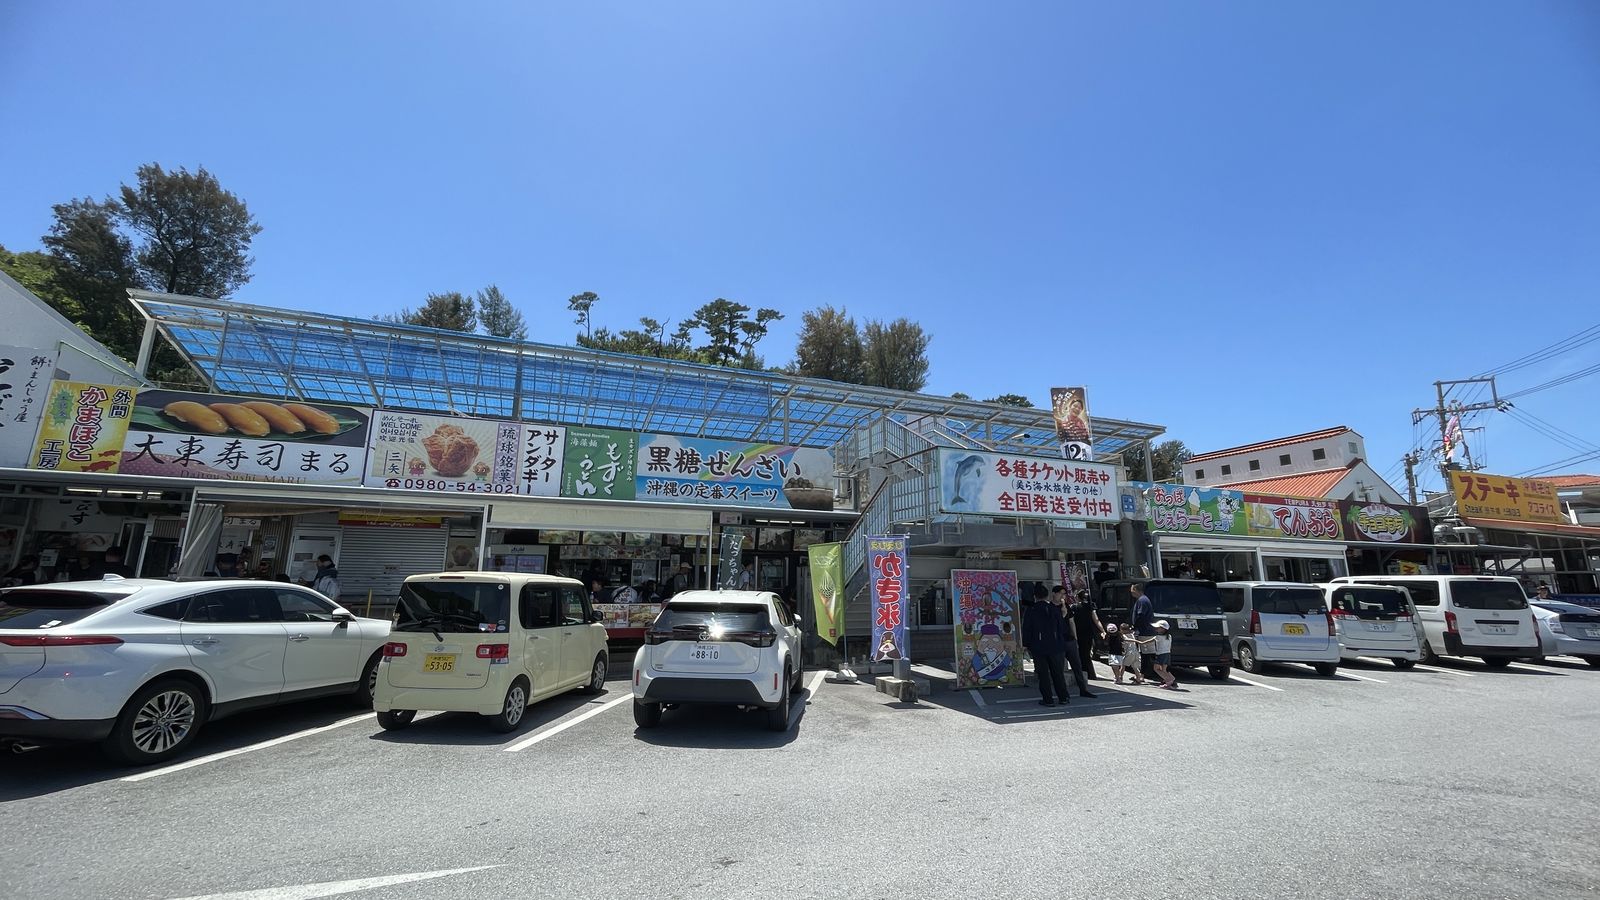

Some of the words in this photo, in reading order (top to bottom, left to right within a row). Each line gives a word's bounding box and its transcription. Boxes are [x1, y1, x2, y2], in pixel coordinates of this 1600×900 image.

[109, 390, 132, 418] 外間
[67, 386, 108, 461] かまぼこ
[380, 422, 423, 430] WELCOME
[37, 440, 64, 469] 工房
[126, 434, 285, 471] 大東寿司
[300, 450, 350, 475] まる
[388, 452, 402, 475] 三矢
[499, 428, 516, 482] 琉球銘菓
[522, 429, 541, 495] アンダギー
[540, 429, 559, 483] サーター
[646, 445, 802, 480] 黒糖ぜんざい
[597, 443, 624, 495] もずく
[995, 458, 1111, 486] 各種チケット販売中
[404, 478, 520, 495] 0980-54-3021
[646, 478, 779, 502] 沖縄の定番スイーツ
[1458, 475, 1520, 504] ステーキ
[997, 491, 1113, 517] 全国発送受付中
[1528, 501, 1557, 516] タコライス
[1152, 507, 1213, 532] じぇらーと
[1273, 507, 1339, 539] てんぷら
[725, 541, 739, 586] たっちゃん
[430, 661, 452, 670] 53-05
[696, 650, 719, 660] 88-10
